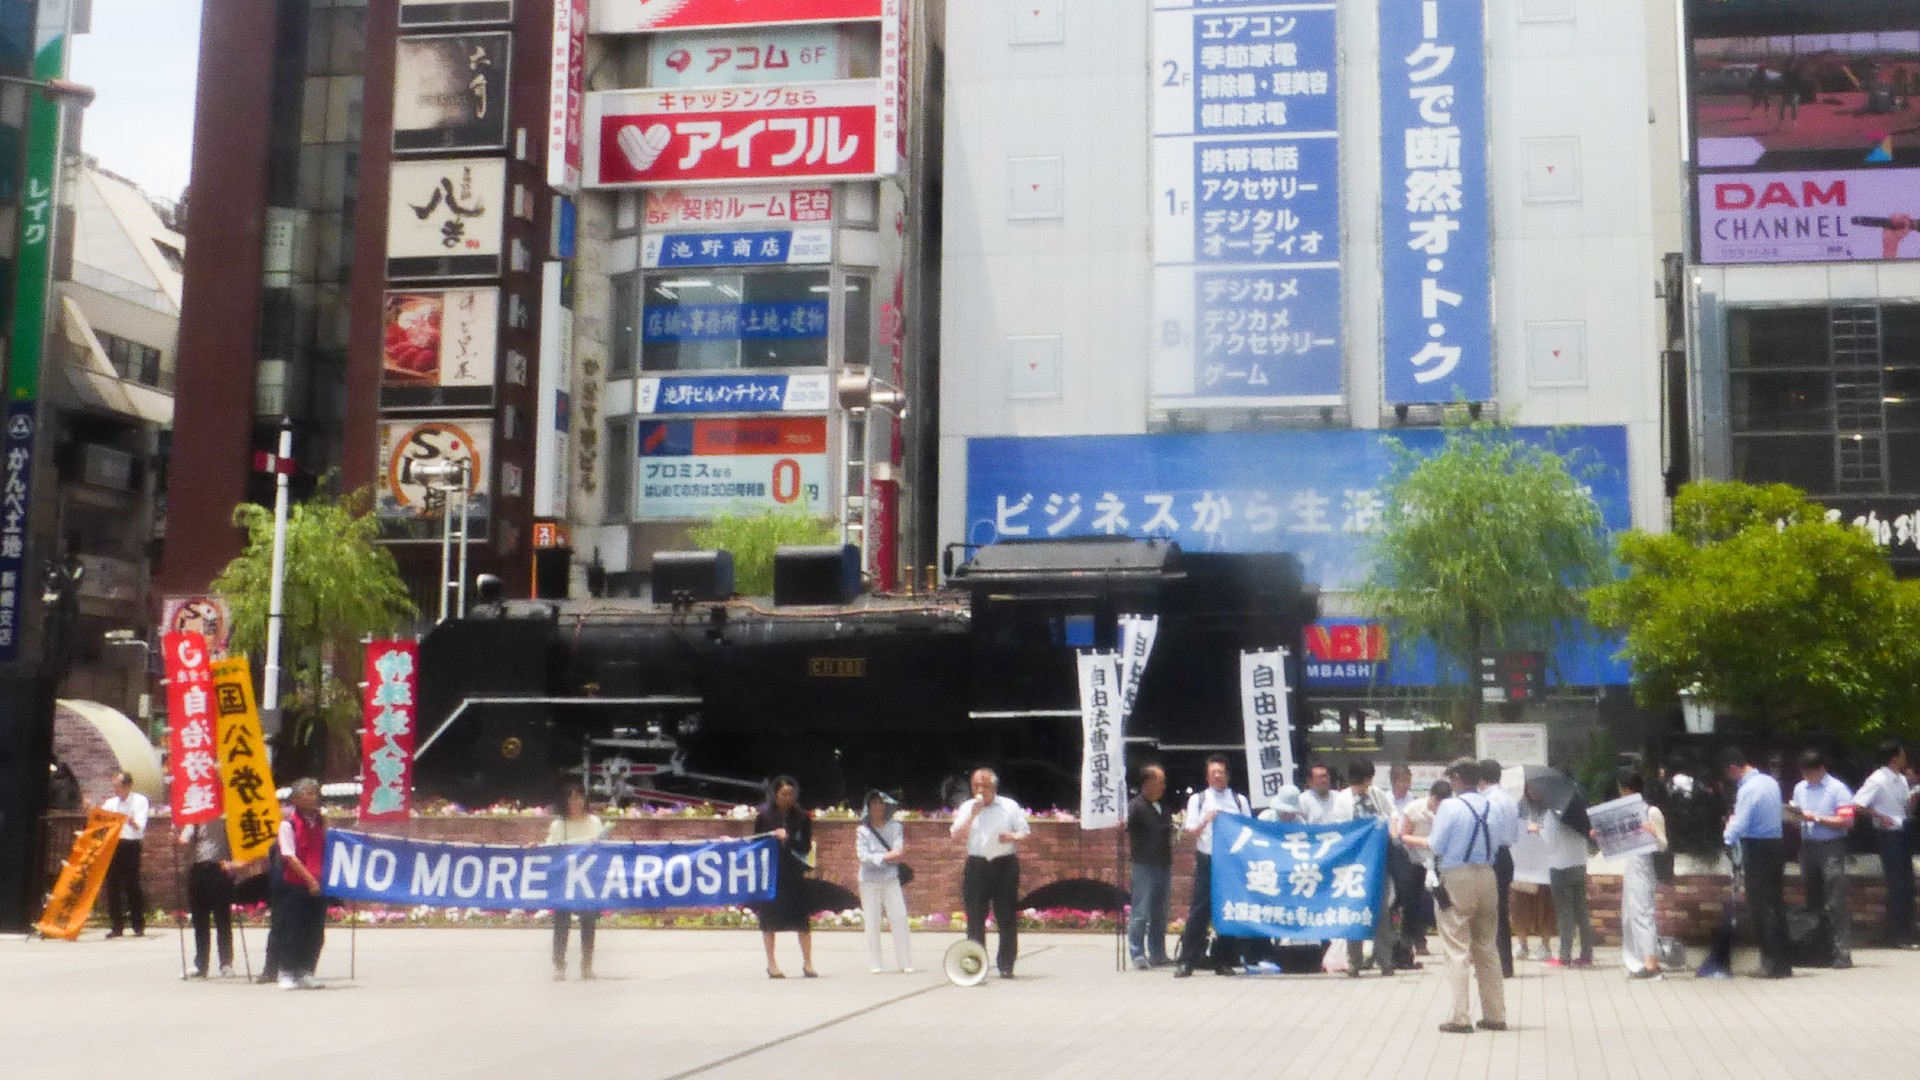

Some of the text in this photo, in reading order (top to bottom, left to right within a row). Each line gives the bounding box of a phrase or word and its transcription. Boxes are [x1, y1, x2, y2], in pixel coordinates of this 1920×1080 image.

[1202, 16, 1296, 38] エアコン
[706, 45, 789, 72] アコム
[1201, 43, 1297, 69] 季節家電
[1161, 60, 1191, 88] 2F
[658, 88, 818, 111] キャッシングなら
[1201, 102, 1287, 128] 健康家電
[675, 116, 859, 170] アイフル
[1201, 147, 1299, 173] 携帯電話
[1164, 188, 1190, 216] 1F
[1202, 178, 1318, 202] アクセサリー
[1714, 180, 1847, 210] DAM
[25, 178, 52, 245] レイク
[682, 197, 785, 220] 契約ルーム
[1203, 209, 1298, 233] デジタル
[1714, 215, 1848, 240] CHANNEL
[671, 237, 781, 259] 池野商店
[1203, 231, 1323, 256] オーディオ
[1203, 278, 1299, 303] デジカメ
[1203, 309, 1291, 331] デジカメ
[1203, 331, 1336, 356] アクセサリー
[1203, 362, 1269, 387] ゲーム
[664, 382, 781, 406] 池野ビルメンテナンス
[215, 682, 278, 849] 国公労連
[1229, 826, 1343, 861] ノーモア
[328, 841, 770, 899] NO MORE KAROSHI
[1245, 859, 1367, 898] 過労死
